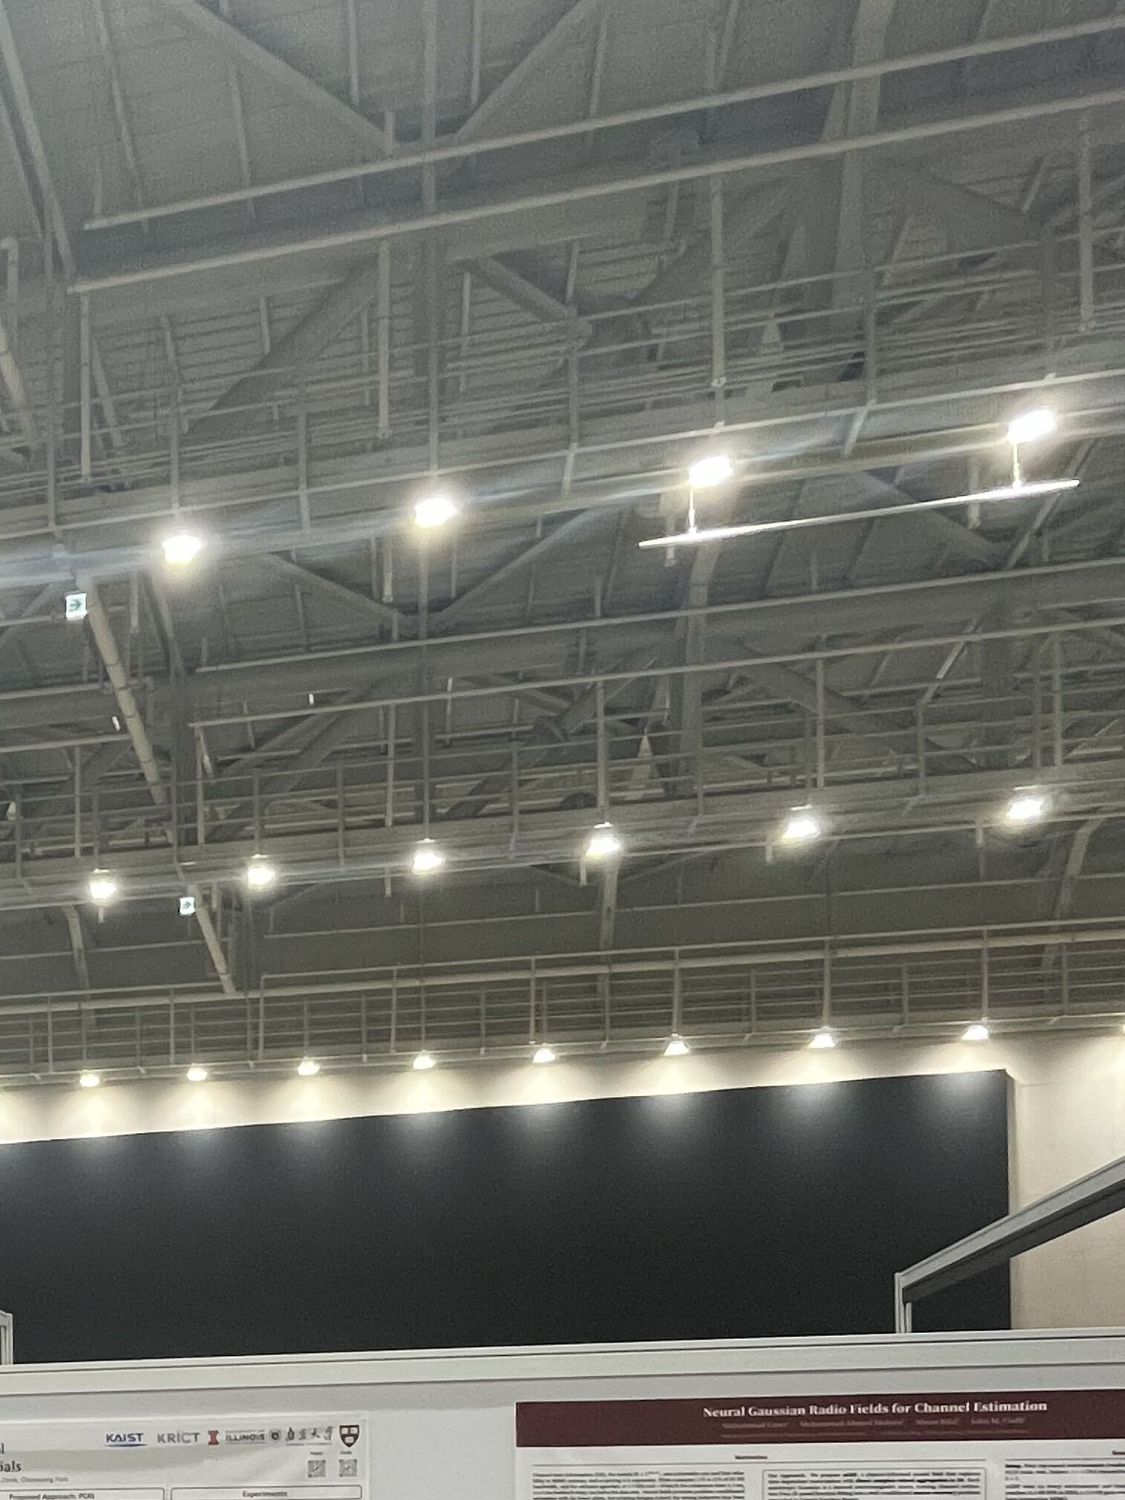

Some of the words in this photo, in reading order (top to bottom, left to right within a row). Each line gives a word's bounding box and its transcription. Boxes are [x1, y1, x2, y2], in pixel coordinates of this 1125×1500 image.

[702, 1406, 745, 1417] Neural
[748, 1401, 805, 1416] Gaussian
[809, 1404, 847, 1415] Radio
[850, 1403, 889, 1414] Fields
[892, 1402, 912, 1413] for
[914, 1402, 970, 1414] Channel
[973, 1400, 1048, 1412] Estimation
[106, 1432, 144, 1443] KAIST
[157, 1431, 200, 1444] KRICT
